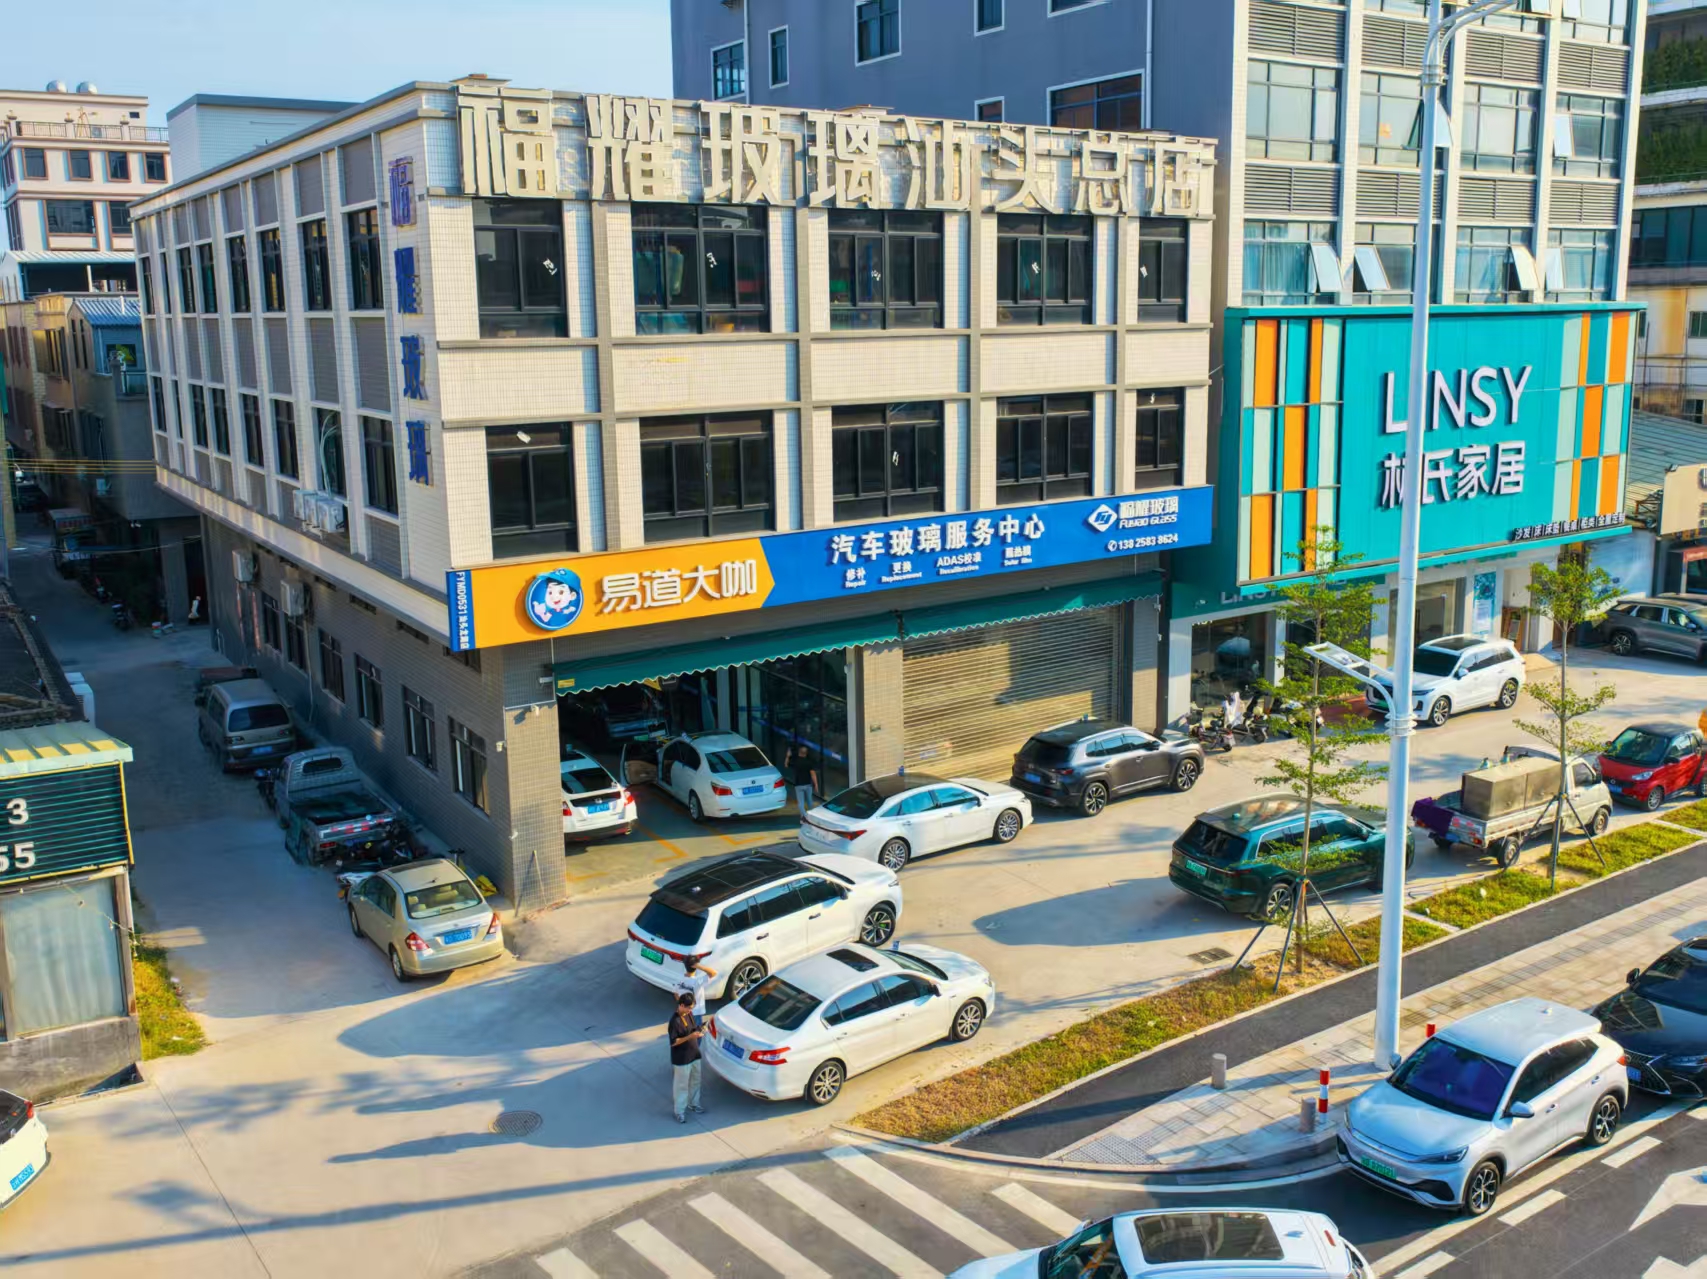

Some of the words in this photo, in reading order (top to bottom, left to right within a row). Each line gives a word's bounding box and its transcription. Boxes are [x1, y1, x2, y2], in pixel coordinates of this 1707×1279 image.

[458, 85, 1213, 217] 福耀玻璃汕头总店
[830, 512, 1046, 564] 汽车玻璃服务中心
[1118, 539, 1135, 550] 138
[1135, 536, 1157, 548] 2583
[1157, 533, 1179, 544] 8624
[601, 558, 758, 614] 易道大咖
